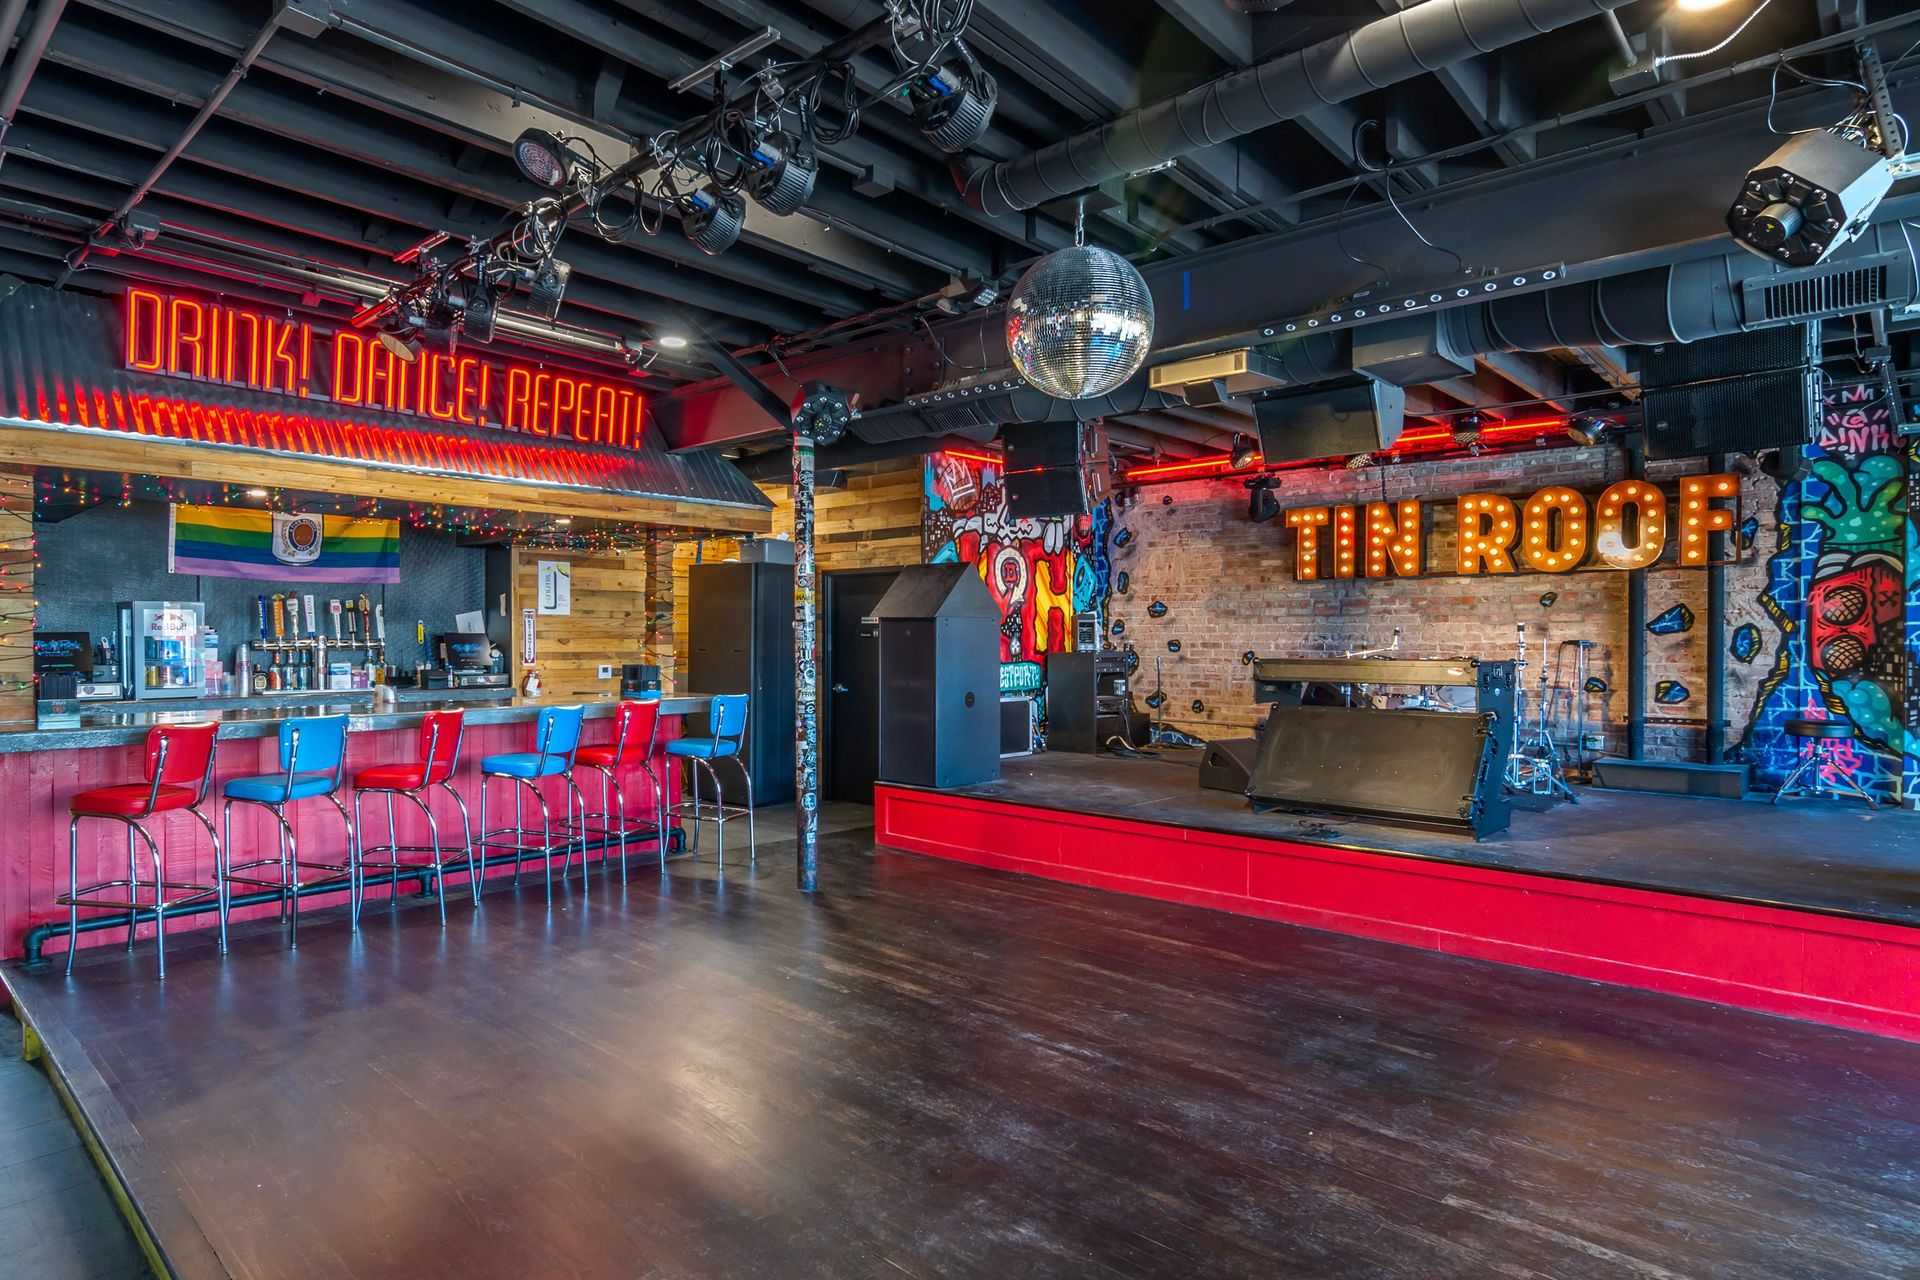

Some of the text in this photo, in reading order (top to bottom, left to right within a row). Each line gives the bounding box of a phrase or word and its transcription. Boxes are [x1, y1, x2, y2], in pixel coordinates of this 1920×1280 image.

[127, 288, 644, 449] DRINK! DANCE! REPEAT!
[1286, 473, 1740, 580] TIN ROOF
